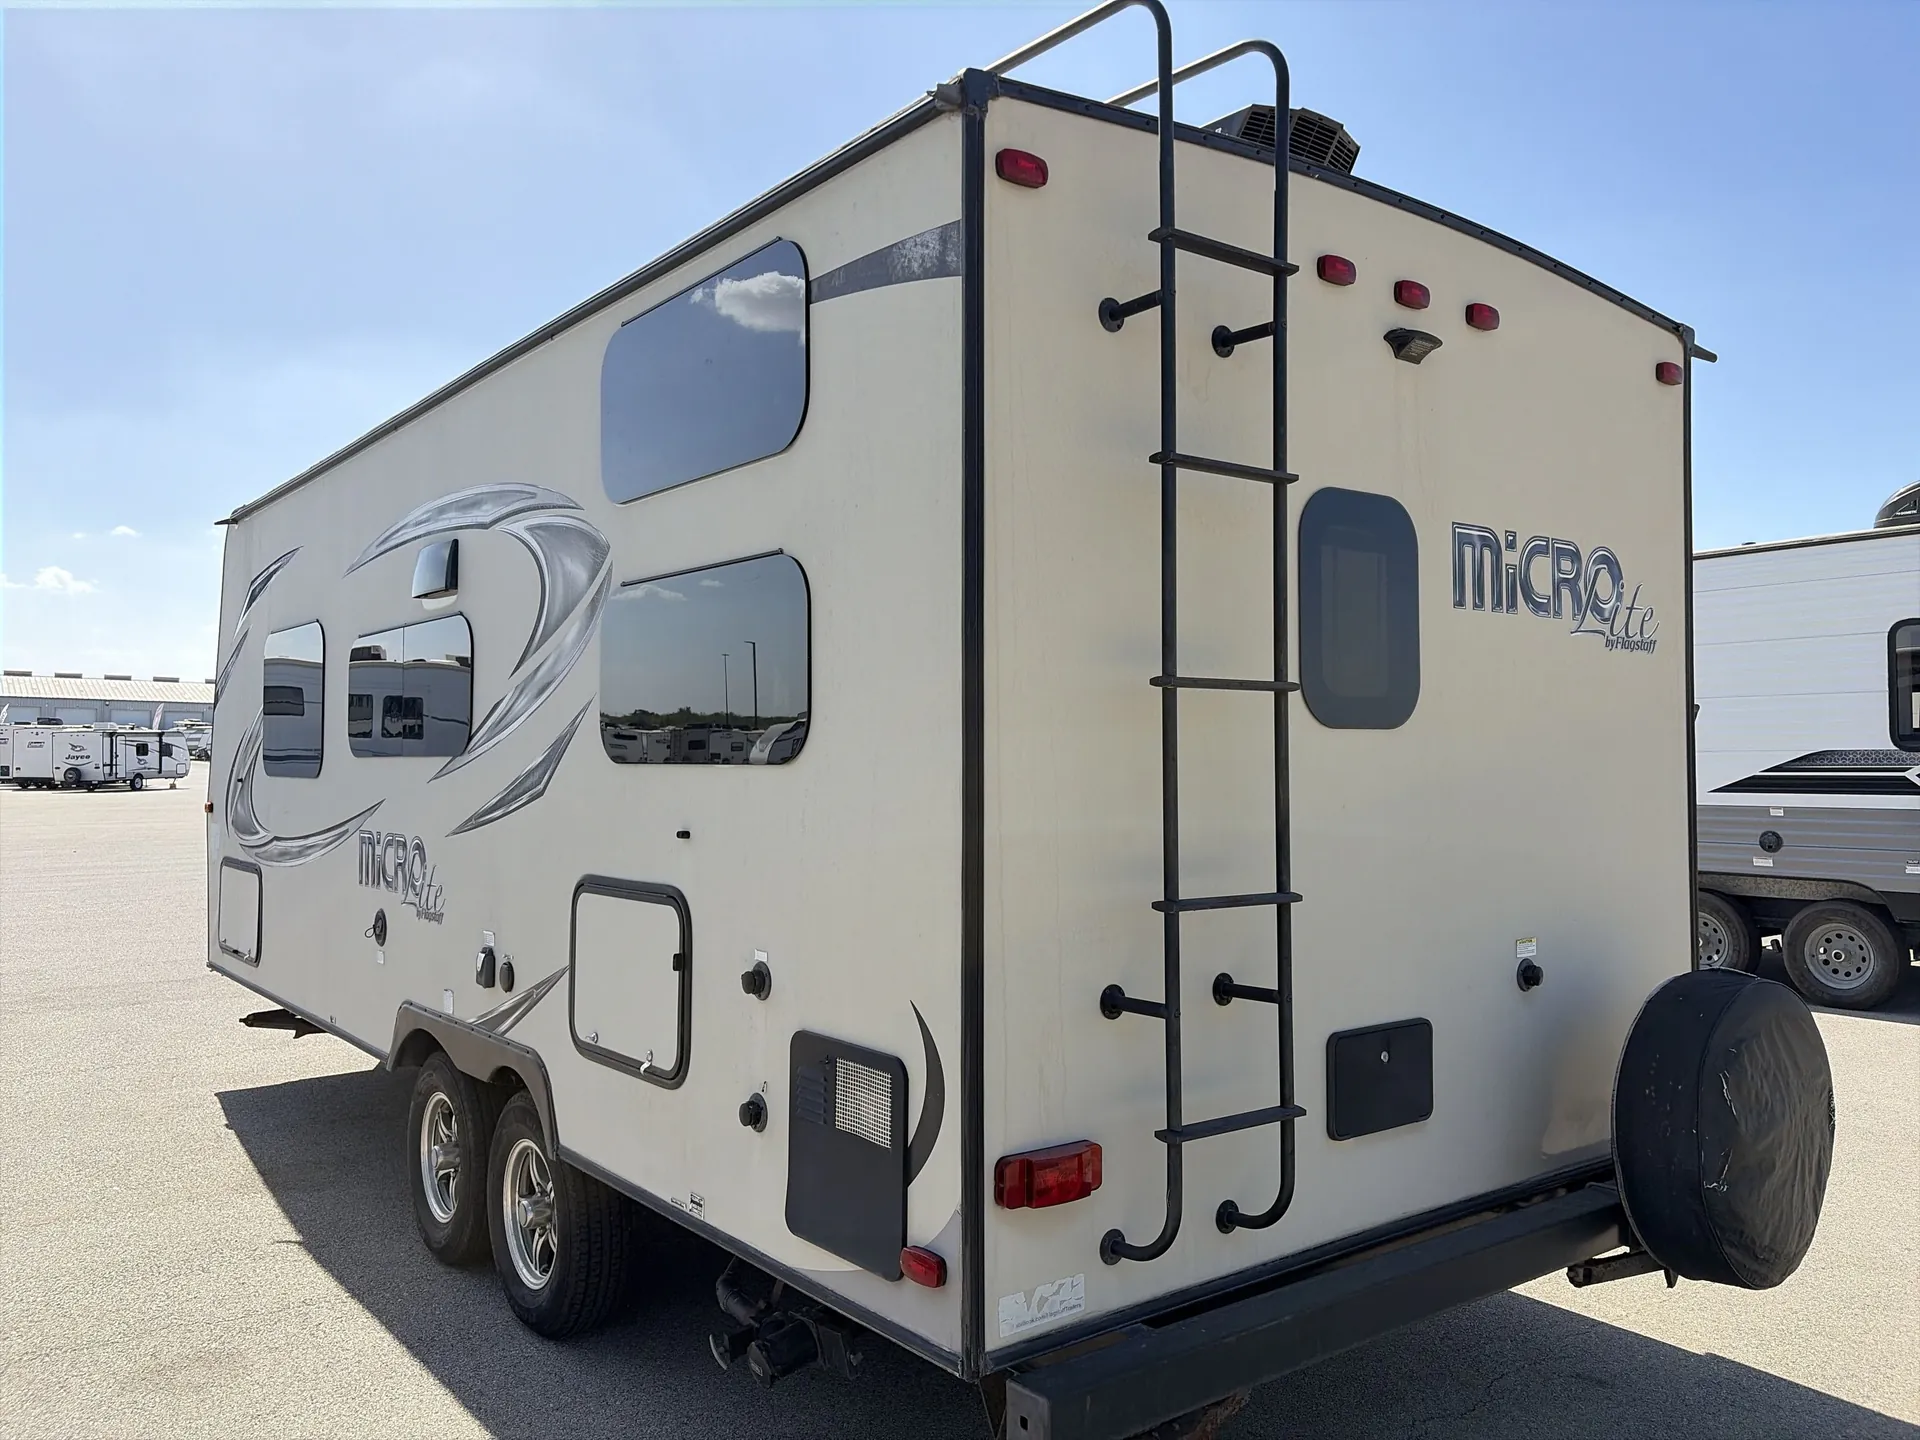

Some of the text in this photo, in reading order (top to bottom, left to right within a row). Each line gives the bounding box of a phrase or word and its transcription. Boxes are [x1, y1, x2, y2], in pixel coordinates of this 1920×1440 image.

[1570, 564, 1660, 639] Lite
[1615, 636, 1658, 654] Flagstaff
[65, 753, 91, 761] Jayco
